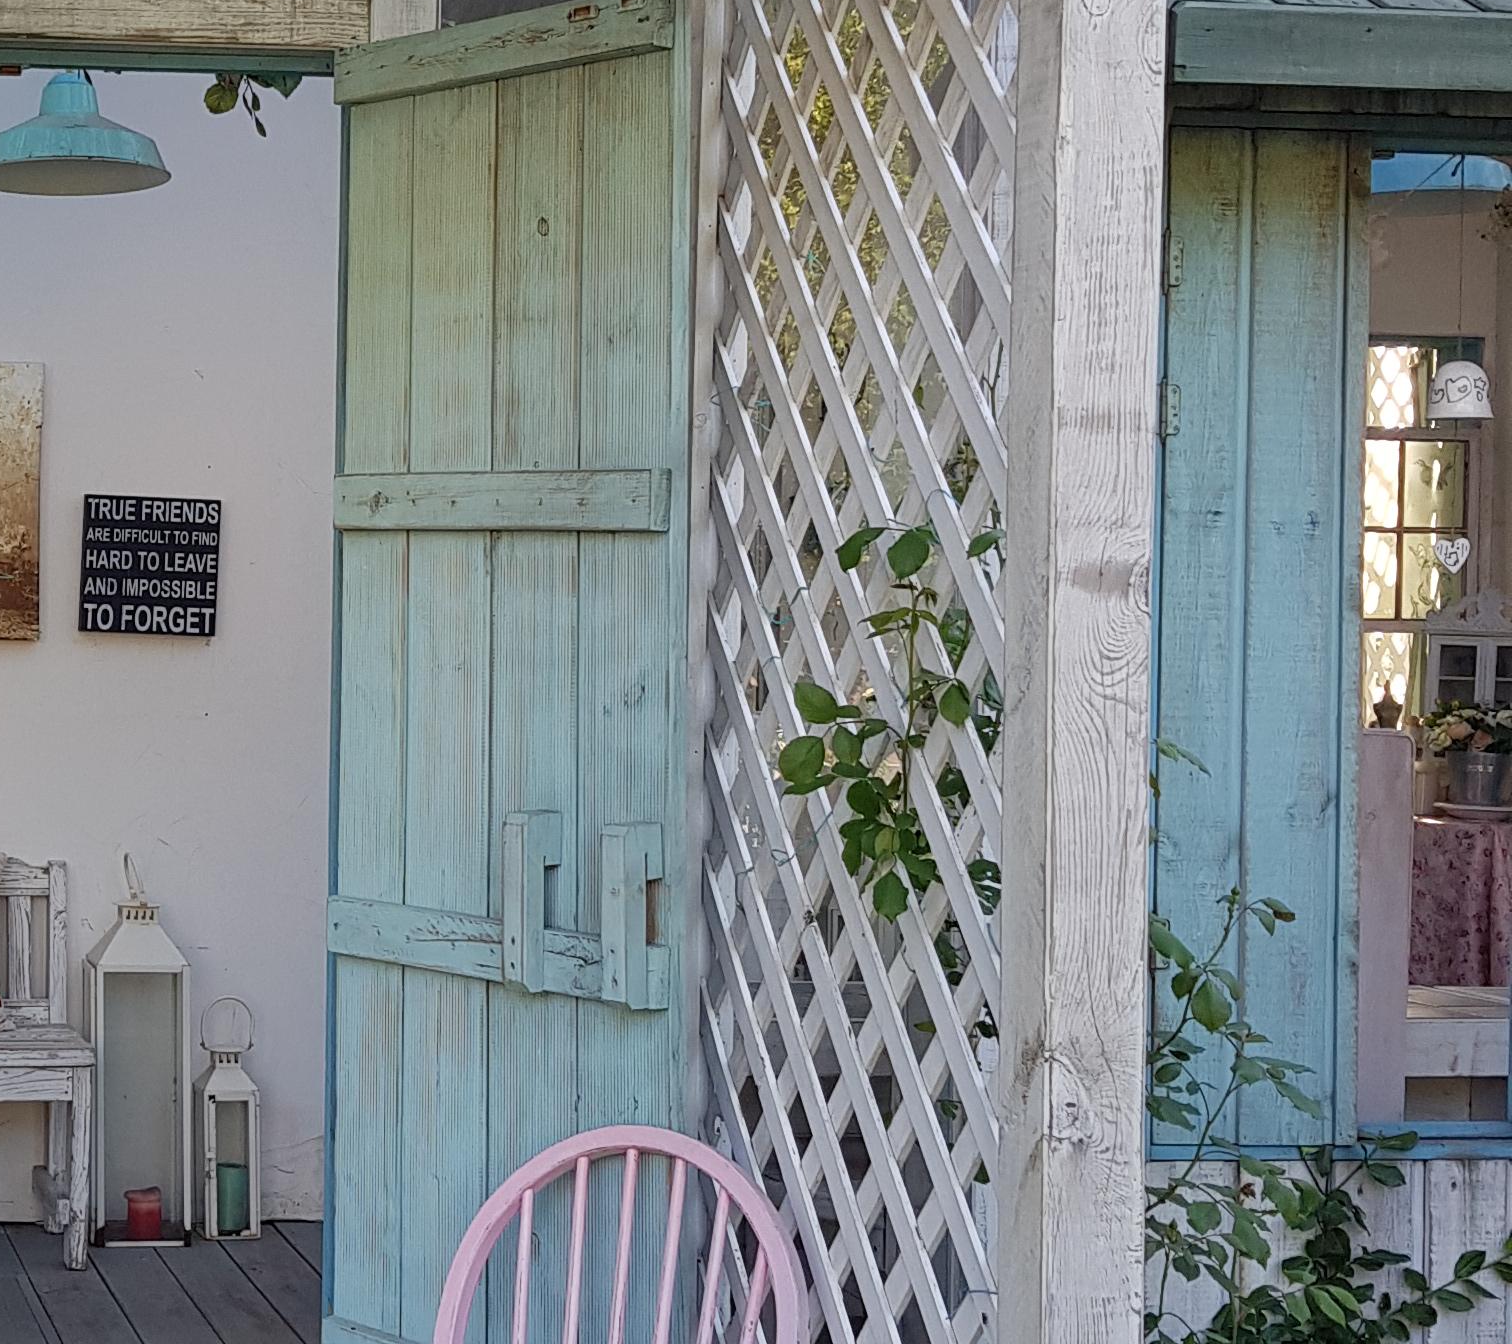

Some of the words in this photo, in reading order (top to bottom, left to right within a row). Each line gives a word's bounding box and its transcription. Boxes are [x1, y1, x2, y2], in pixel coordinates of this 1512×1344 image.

[88, 498, 136, 521] TRUE
[141, 500, 219, 524] FRIENDS
[86, 527, 110, 542] ARE
[113, 529, 171, 544] DIFFICULT
[173, 531, 189, 545] TO
[192, 532, 218, 546] FIND
[86, 549, 132, 570] HARD
[138, 551, 160, 571] TO
[164, 552, 217, 574] LEAVE
[84, 577, 117, 596] AND
[121, 578, 216, 600] IMPOSSIBLE
[84, 603, 114, 630] TO
[120, 604, 215, 634] FORGET
